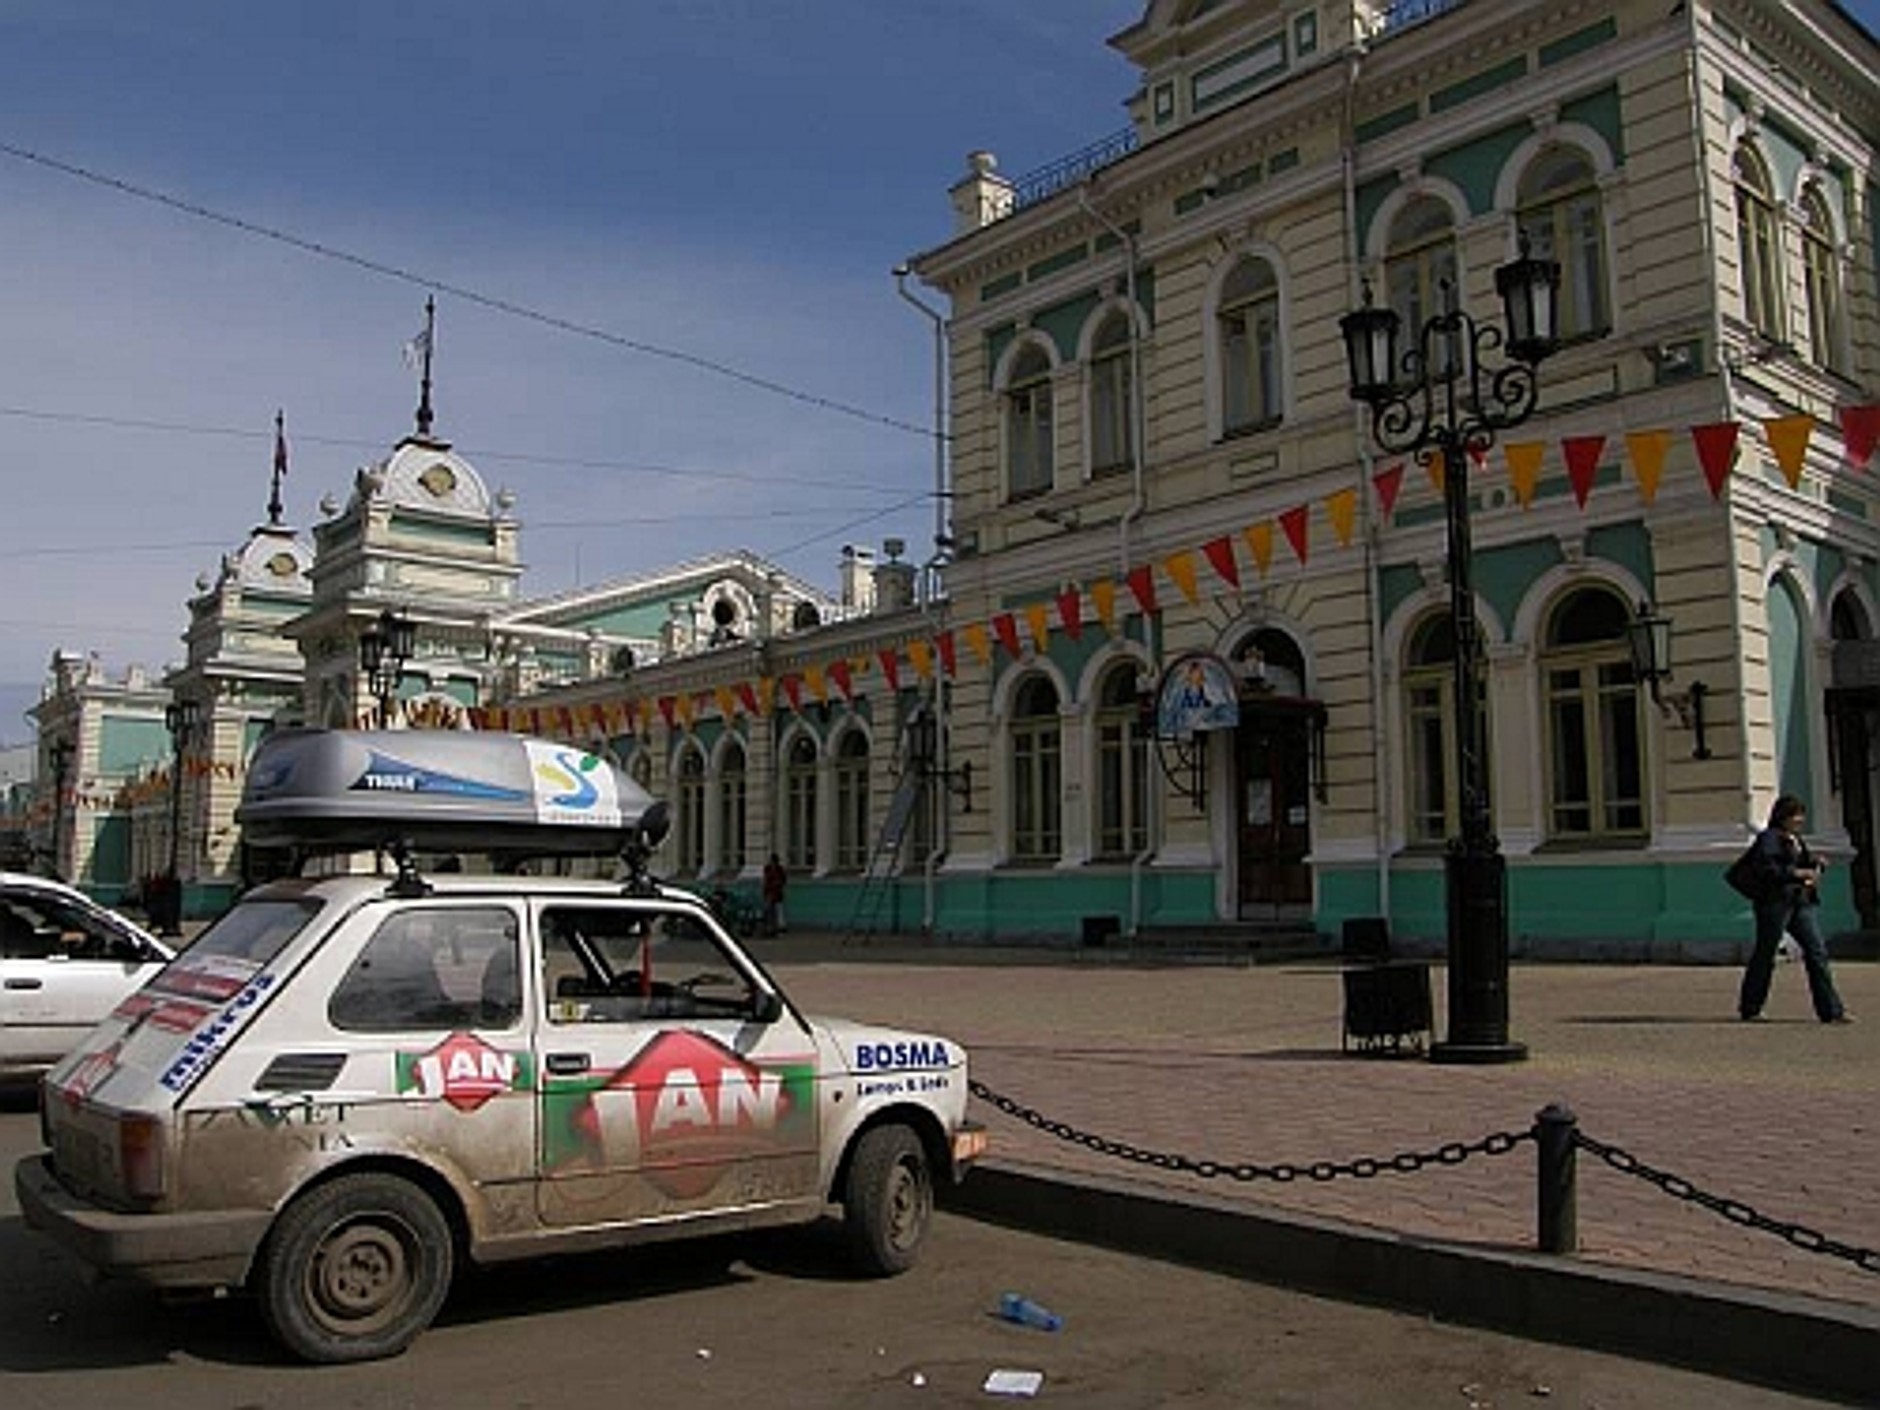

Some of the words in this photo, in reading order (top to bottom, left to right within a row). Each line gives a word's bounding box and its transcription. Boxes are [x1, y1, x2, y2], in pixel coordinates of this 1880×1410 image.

[401, 1050, 515, 1104] JAN
[857, 1042, 949, 1069] BOSMA
[554, 1066, 782, 1180] JAN
